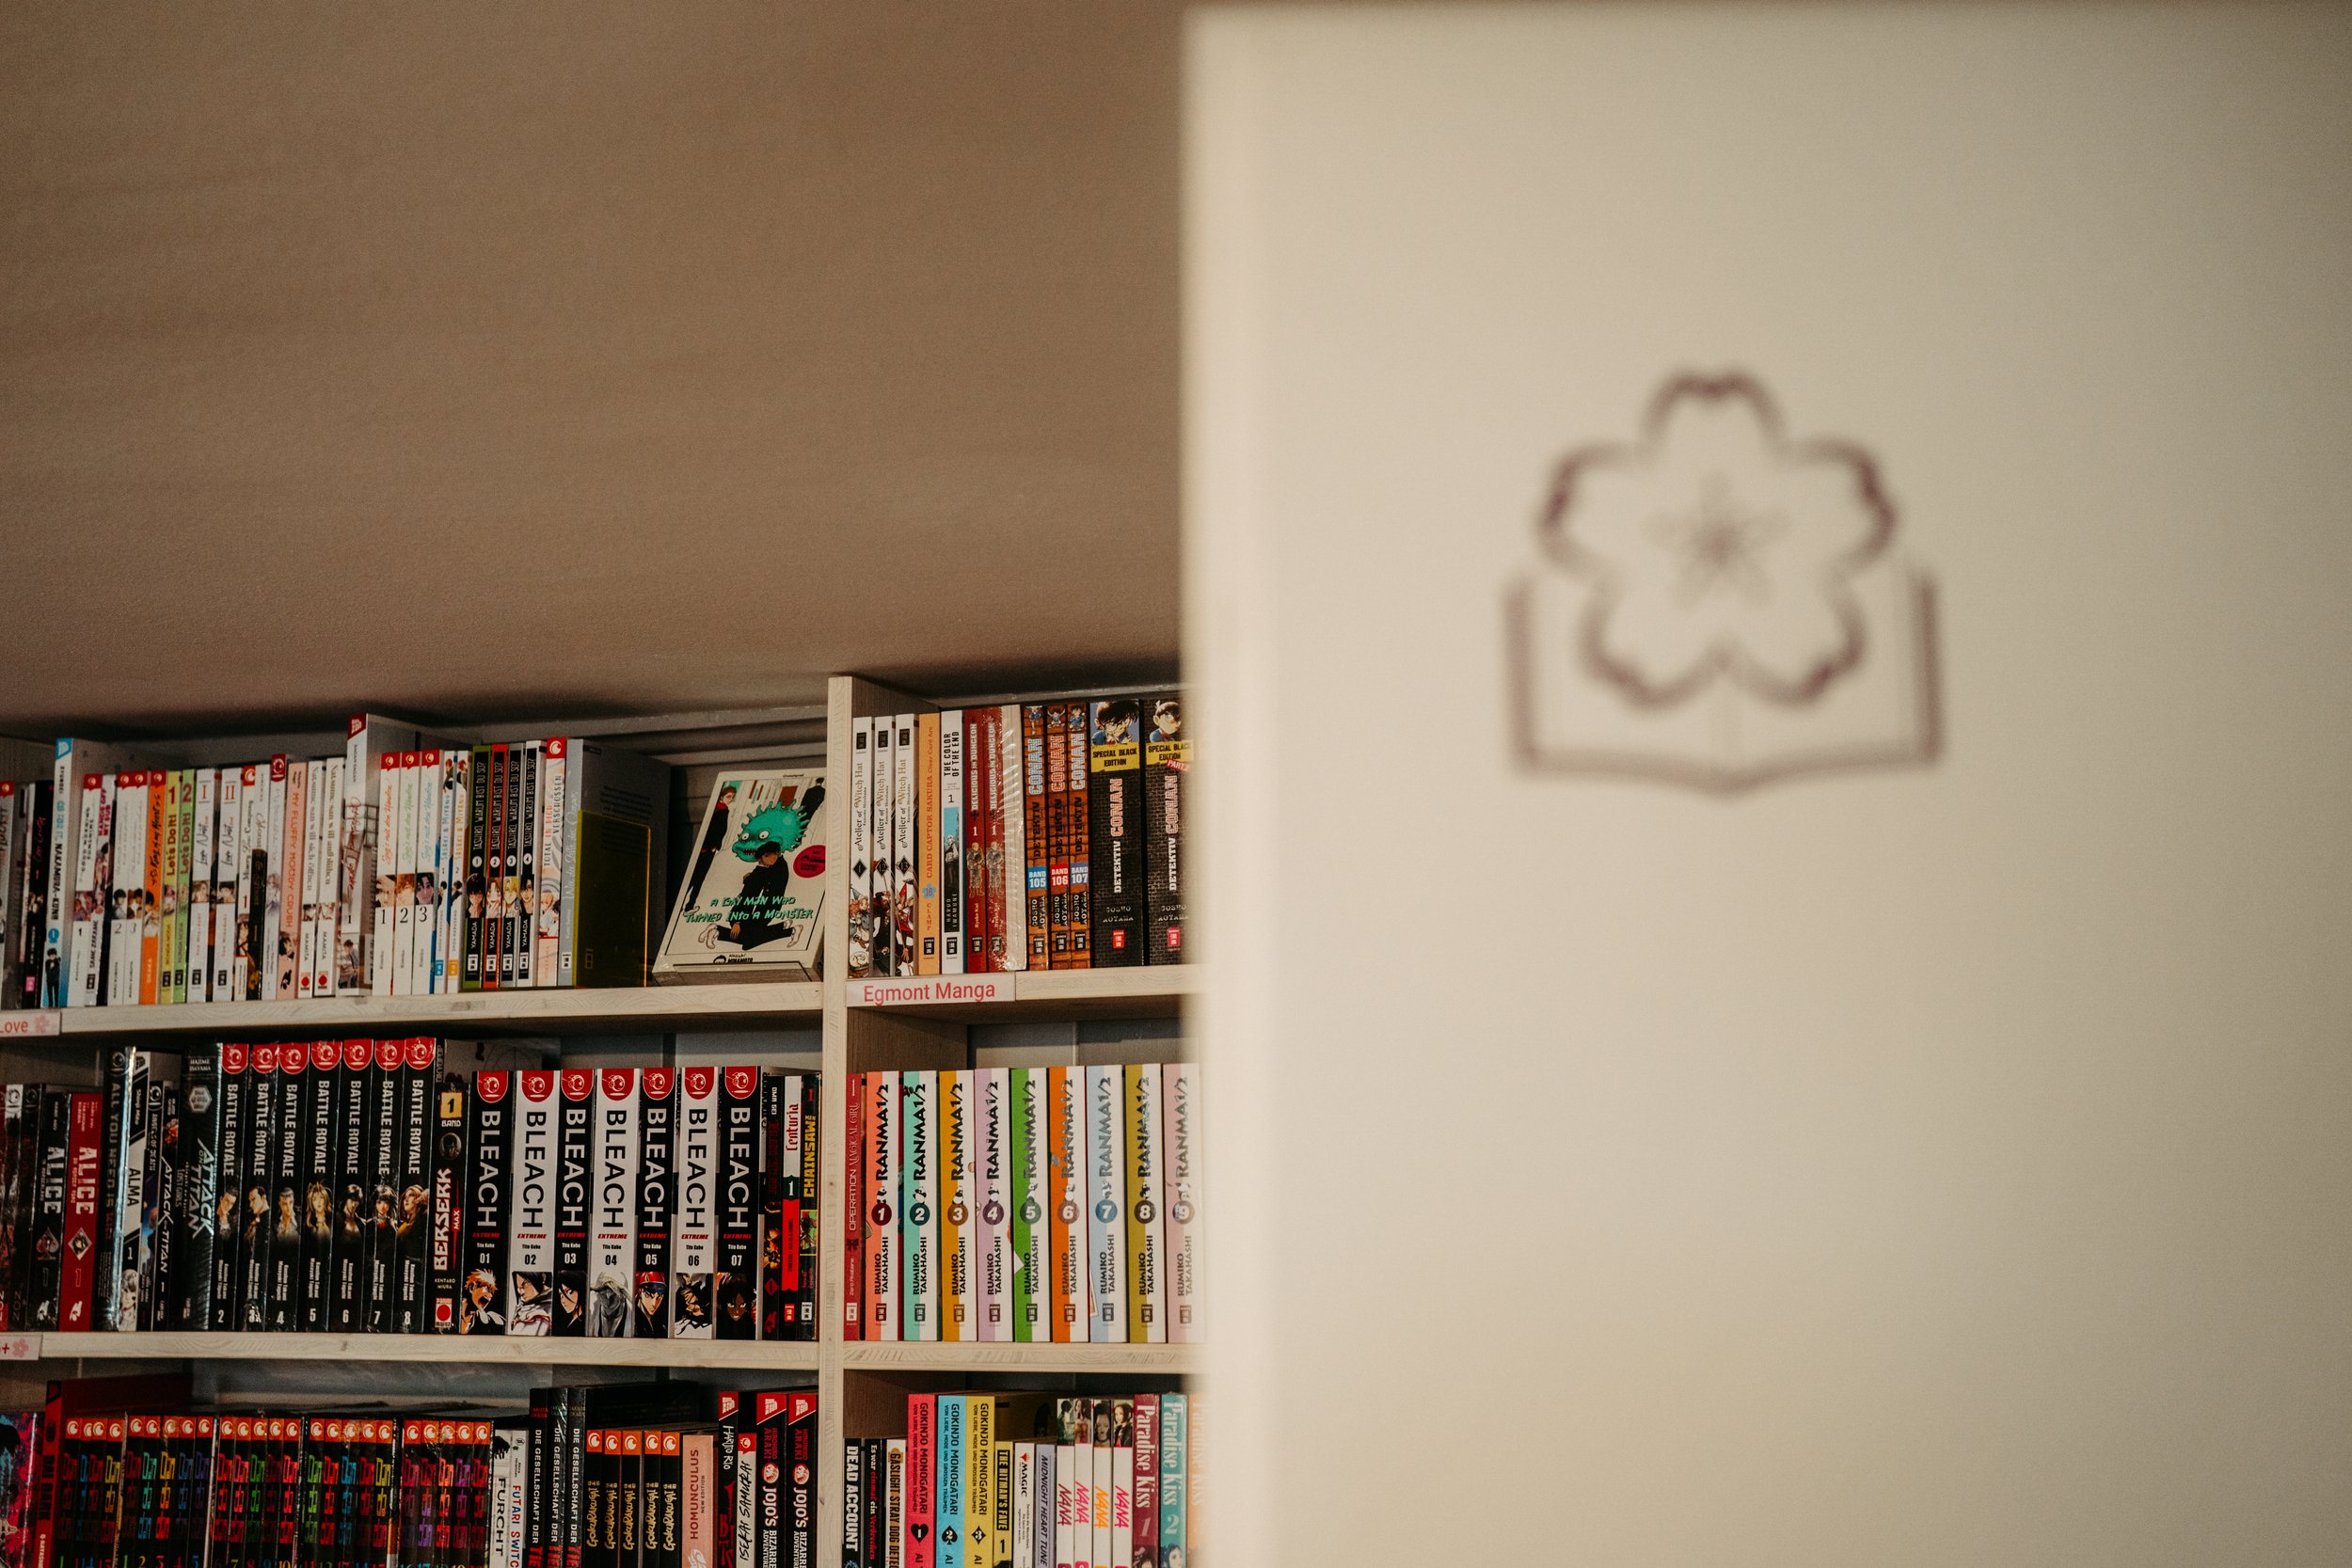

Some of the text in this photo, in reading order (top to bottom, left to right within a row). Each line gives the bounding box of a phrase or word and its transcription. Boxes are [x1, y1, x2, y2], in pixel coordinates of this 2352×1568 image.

[952, 765, 960, 777] OF
[1028, 738, 1042, 796] CONAN
[1050, 736, 1065, 793] CONAN
[1071, 733, 1086, 790] CONAN
[1093, 748, 1137, 758] SPECIAL BLACK
[1104, 758, 1127, 767] EDITION
[169, 786, 175, 804] 1
[293, 792, 299, 808] MY
[473, 761, 486, 850] TASHIRO, WARUM BIST DU SO?
[553, 775, 562, 834] VERSCHOSSEN
[854, 780, 863, 808] Witch
[1109, 778, 1123, 837] CONAN
[1165, 775, 1179, 834] CONAN
[103, 820, 110, 835] MY
[290, 810, 299, 848] FLUFFY
[543, 804, 553, 866] TOTAL IN DICH
[854, 818, 864, 851] Atelier
[167, 847, 176, 876] Let's
[288, 852, 296, 890] MOODY
[1028, 869, 1046, 878] BAND
[1052, 876, 1069, 886] 106
[1071, 865, 1088, 874] BAND
[1071, 874, 1089, 884] 107
[1028, 878, 1047, 888] 105
[380, 910, 386, 924] 1
[400, 908, 408, 924] 2
[419, 906, 427, 922] 3
[864, 982, 995, 1006] Egmont Manga
[223, 1084, 238, 1177] BATTLE ROYALE
[314, 1081, 329, 1174] BATTLE ROYALE
[347, 1081, 361, 1175] BATTLE ROYALE
[408, 1080, 423, 1175] BATTLE ROYALE
[786, 1103, 799, 1151] Centuria
[477, 1110, 501, 1227] BLEACH
[522, 1111, 547, 1227] BLEACH
[563, 1109, 586, 1227] BLEACH
[604, 1110, 627, 1227] BLEACH
[644, 1107, 667, 1227] BLEACH
[686, 1108, 707, 1228] BLEACH
[728, 1107, 751, 1227] BLEACH
[803, 1120, 817, 1198] CHAINSAW
[44, 1146, 65, 1214] ALICE
[75, 1146, 98, 1215] ALICE
[127, 1168, 141, 1207] ALMA
[434, 1167, 452, 1271] BERSERK
[878, 1207, 885, 1220] 1
[914, 1207, 925, 1220] 2
[953, 1207, 962, 1220] 3
[988, 1206, 997, 1220] 4
[1025, 1206, 1035, 1219] 5
[1063, 1206, 1073, 1218] 6
[1102, 1205, 1111, 1217] 7
[1140, 1206, 1150, 1218] 8
[479, 1253, 490, 1264] 01
[524, 1254, 536, 1265] 02
[564, 1253, 577, 1264] 03
[605, 1255, 617, 1266] 04
[645, 1254, 658, 1265] 05
[688, 1255, 700, 1266] 06
[731, 1255, 742, 1266] 07
[404, 1311, 411, 1324] 8
[950, 1403, 960, 1514] GOKINJO MONOGATARI
[1136, 1404, 1155, 1508] Paradise Kiss
[1163, 1402, 1184, 1506] Paradise Kiss
[532, 1448, 541, 1522] GESELLSCHAFT
[691, 1449, 699, 1540] HOMUNCULUS
[846, 1446, 859, 1551] DEAD ACCOUNT
[890, 1453, 900, 1543] GASLIGHT STRAY DOG
[919, 1449, 928, 1513] MONOGATARI
[979, 1449, 988, 1514] MONOGATARI
[998, 1450, 1009, 1529] THE HITMAN'S FAVE
[496, 1478, 506, 1557] FURCHT
[512, 1485, 521, 1524] FUTARI
[763, 1486, 779, 1528] JOJO'S
[794, 1487, 808, 1528] JOJO'S
[1057, 1483, 1072, 1526] NANA
[1074, 1481, 1089, 1524] NANA
[1094, 1485, 1109, 1528] NANA
[1115, 1485, 1129, 1528] NANA
[1165, 1514, 1179, 1534] 2
